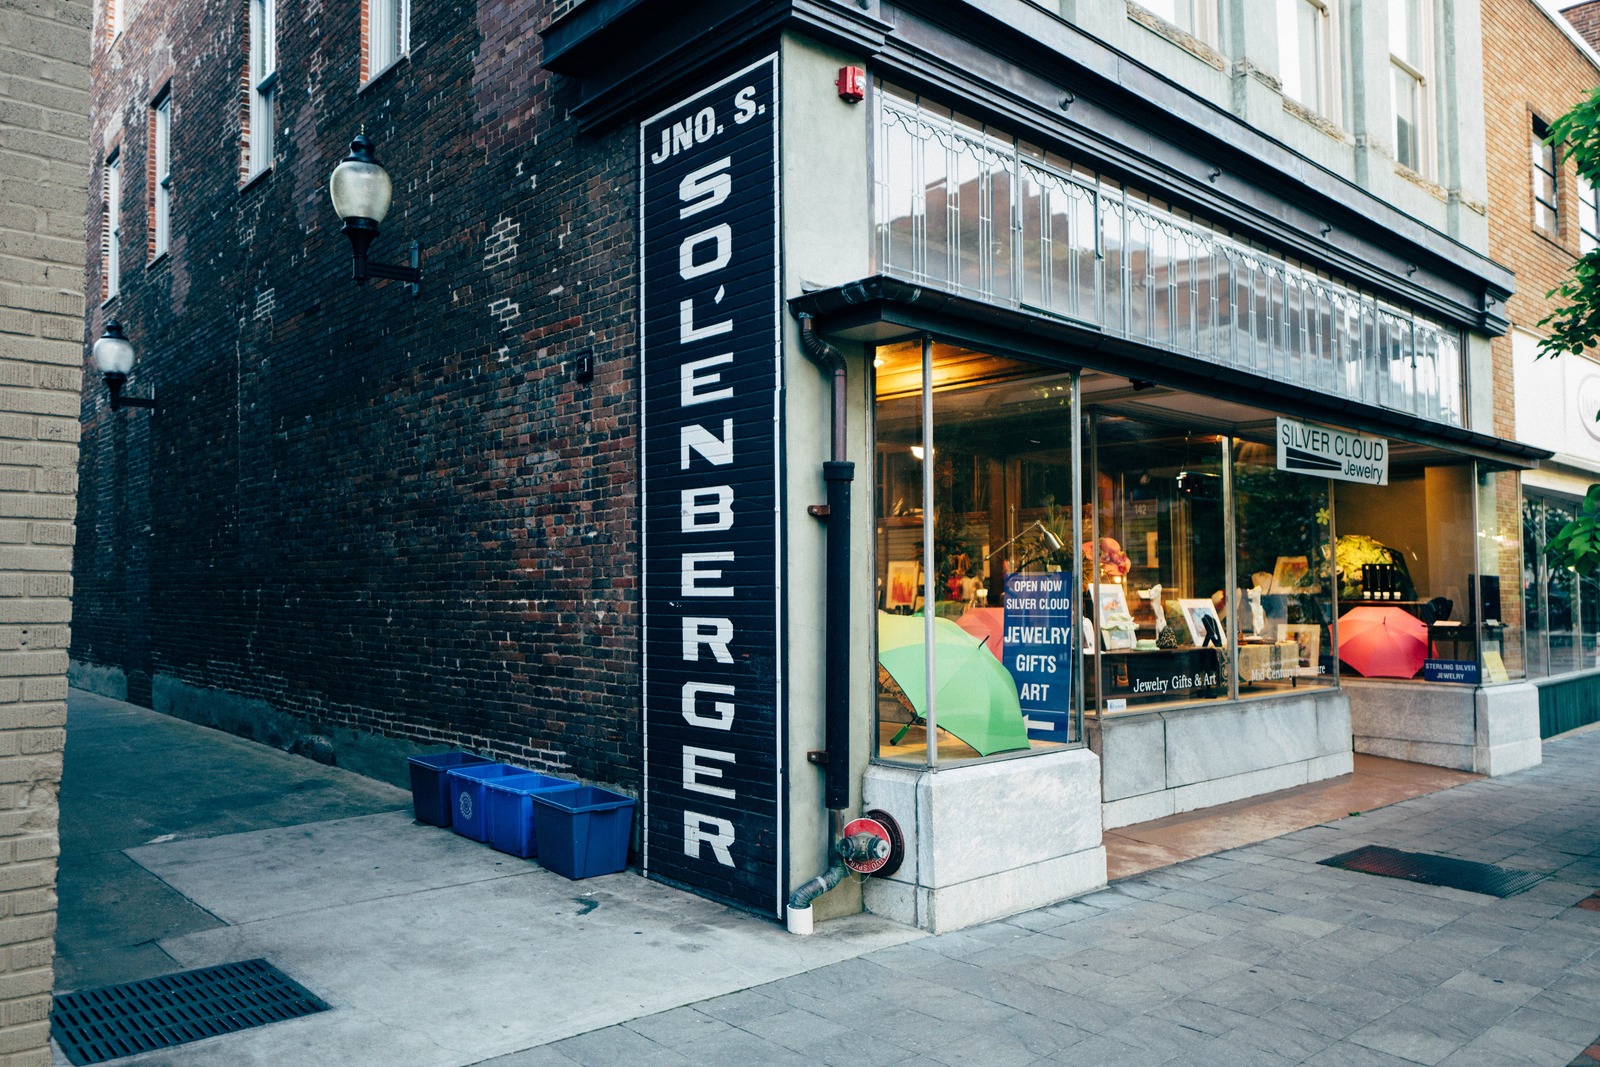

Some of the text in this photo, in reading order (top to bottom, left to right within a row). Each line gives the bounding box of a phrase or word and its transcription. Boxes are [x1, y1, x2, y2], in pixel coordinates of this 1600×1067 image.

[651, 85, 766, 164] JNO. S.
[1281, 423, 1384, 462] SILVER CLOUD
[1344, 459, 1383, 485] Jewelry
[1014, 580, 1062, 592] OPEN NOW
[1006, 598, 1070, 610] SILVER CLOUD
[1004, 626, 1071, 645] JEWELRY
[1016, 654, 1057, 674] GIFTS
[1425, 663, 1476, 672] STERLING SILVER
[1133, 672, 1217, 694] Jewelry Gifts & Art
[1251, 668, 1265, 682] Mid
[1266, 667, 1293, 681] Century
[1436, 672, 1465, 680] JEWELRY
[1020, 683, 1050, 702] ART
